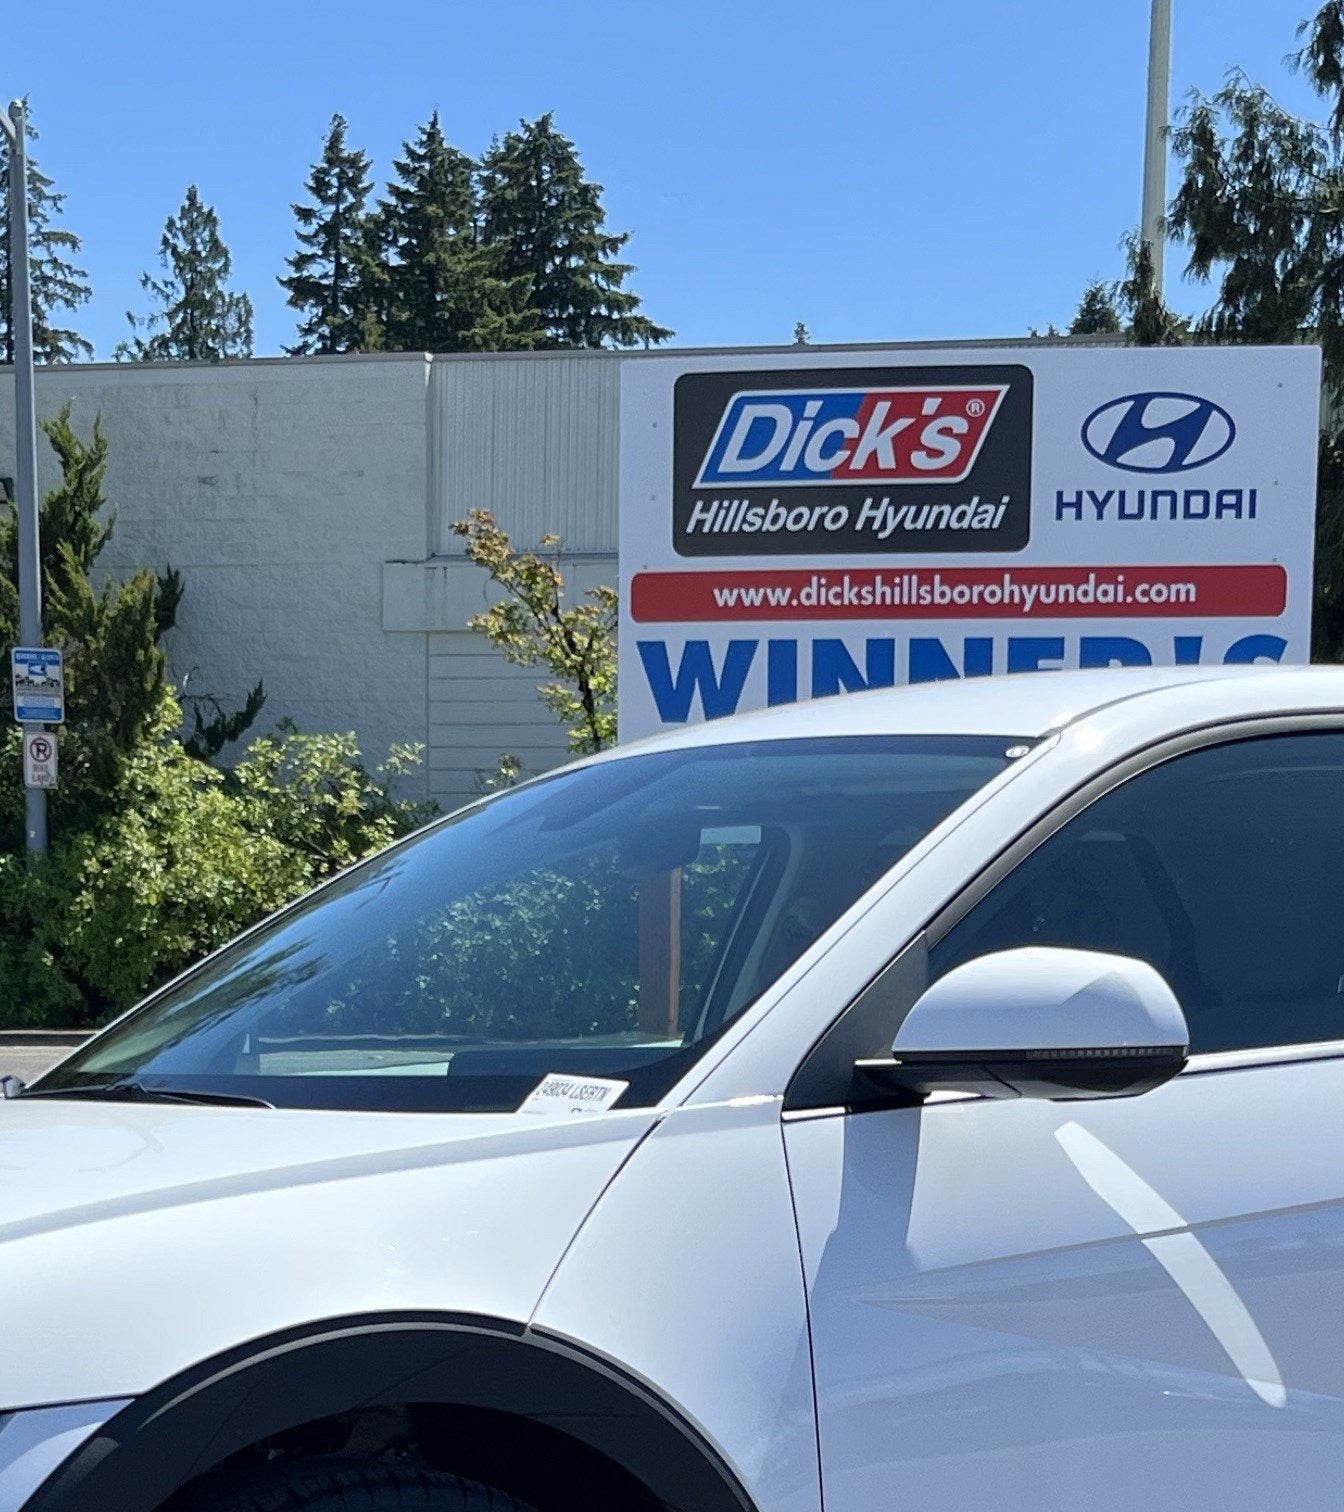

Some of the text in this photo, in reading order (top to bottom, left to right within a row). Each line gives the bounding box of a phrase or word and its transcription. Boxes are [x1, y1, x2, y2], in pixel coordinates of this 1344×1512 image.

[718, 395, 970, 475] Dick's
[685, 496, 1011, 539] Hillsboro Hyundai
[1056, 488, 1257, 522] HYUNDAI
[713, 575, 1197, 611] www.dickshillsborohyundai.com
